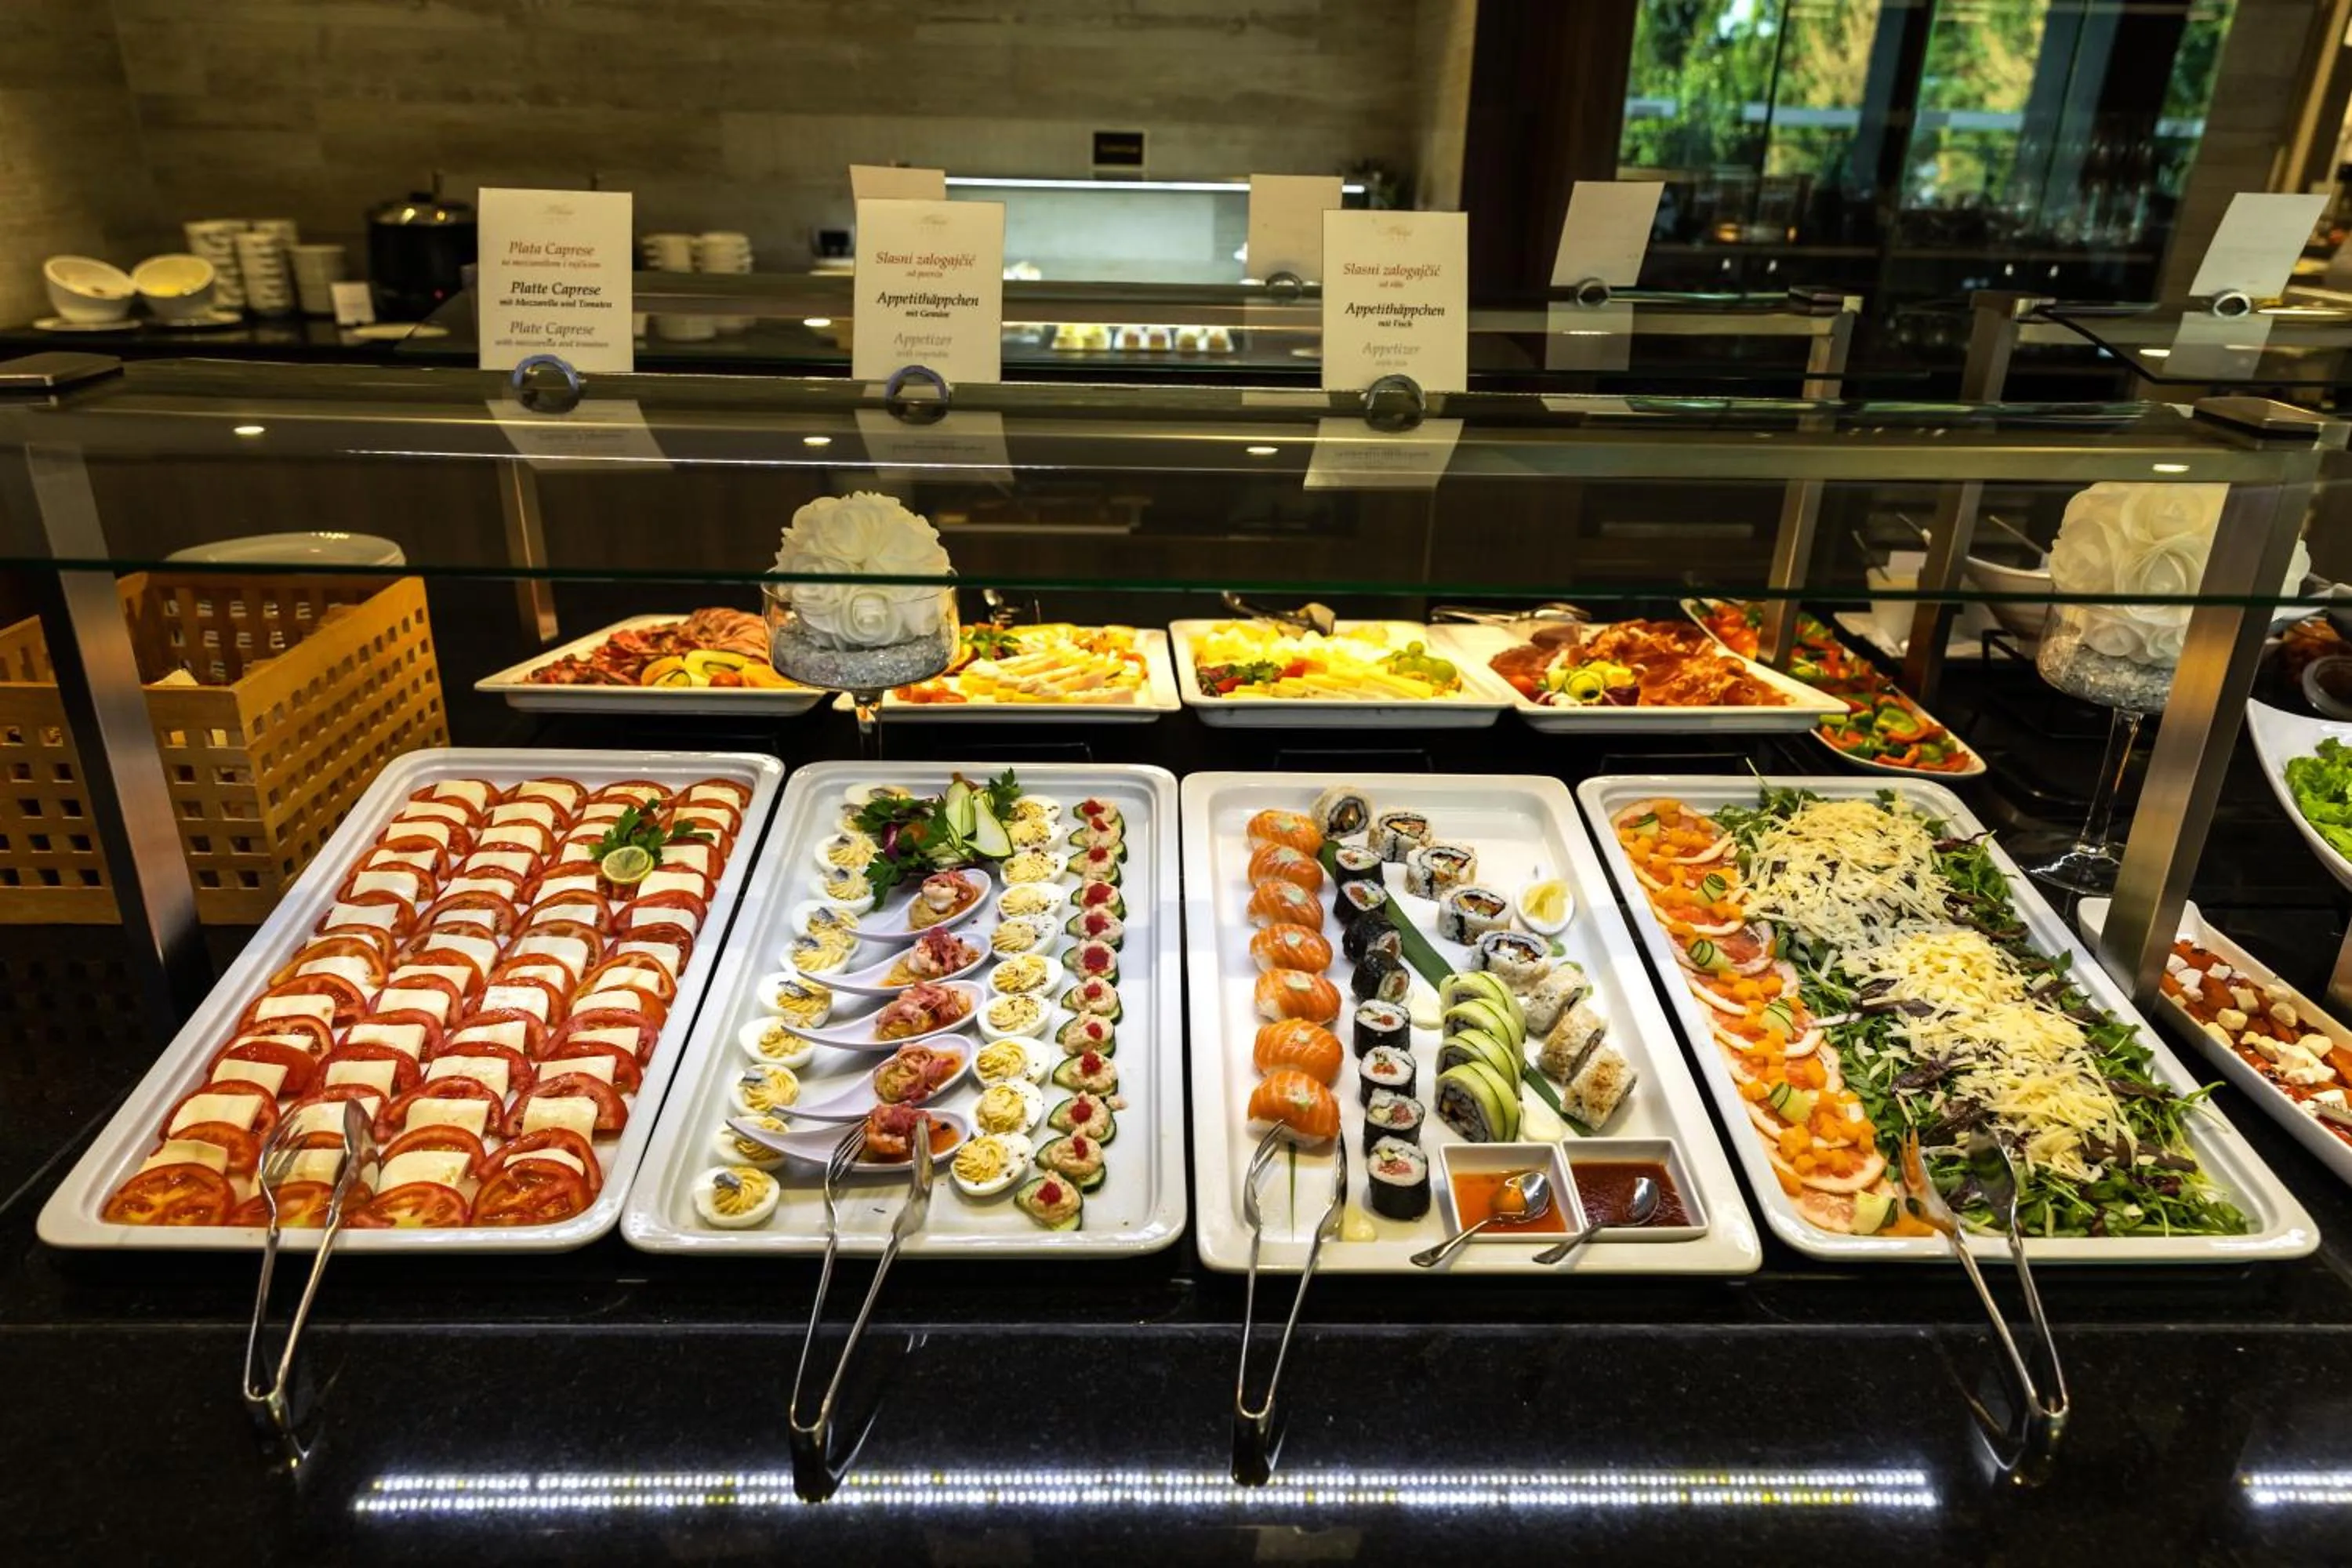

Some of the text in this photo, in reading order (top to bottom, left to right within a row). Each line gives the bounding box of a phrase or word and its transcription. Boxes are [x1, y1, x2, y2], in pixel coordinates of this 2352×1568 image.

[510, 241, 594, 258] Plata Caprese
[876, 252, 913, 265] Slasni
[1343, 263, 1380, 276] Slasni
[510, 281, 601, 297] Platte Caprese
[877, 291, 979, 309] Appetithäppchen
[1345, 302, 1445, 318] Appetithäppchen
[510, 320, 594, 337] Plate Caprese
[894, 332, 953, 348] Appetizer
[1362, 341, 1421, 358] Appetizer
